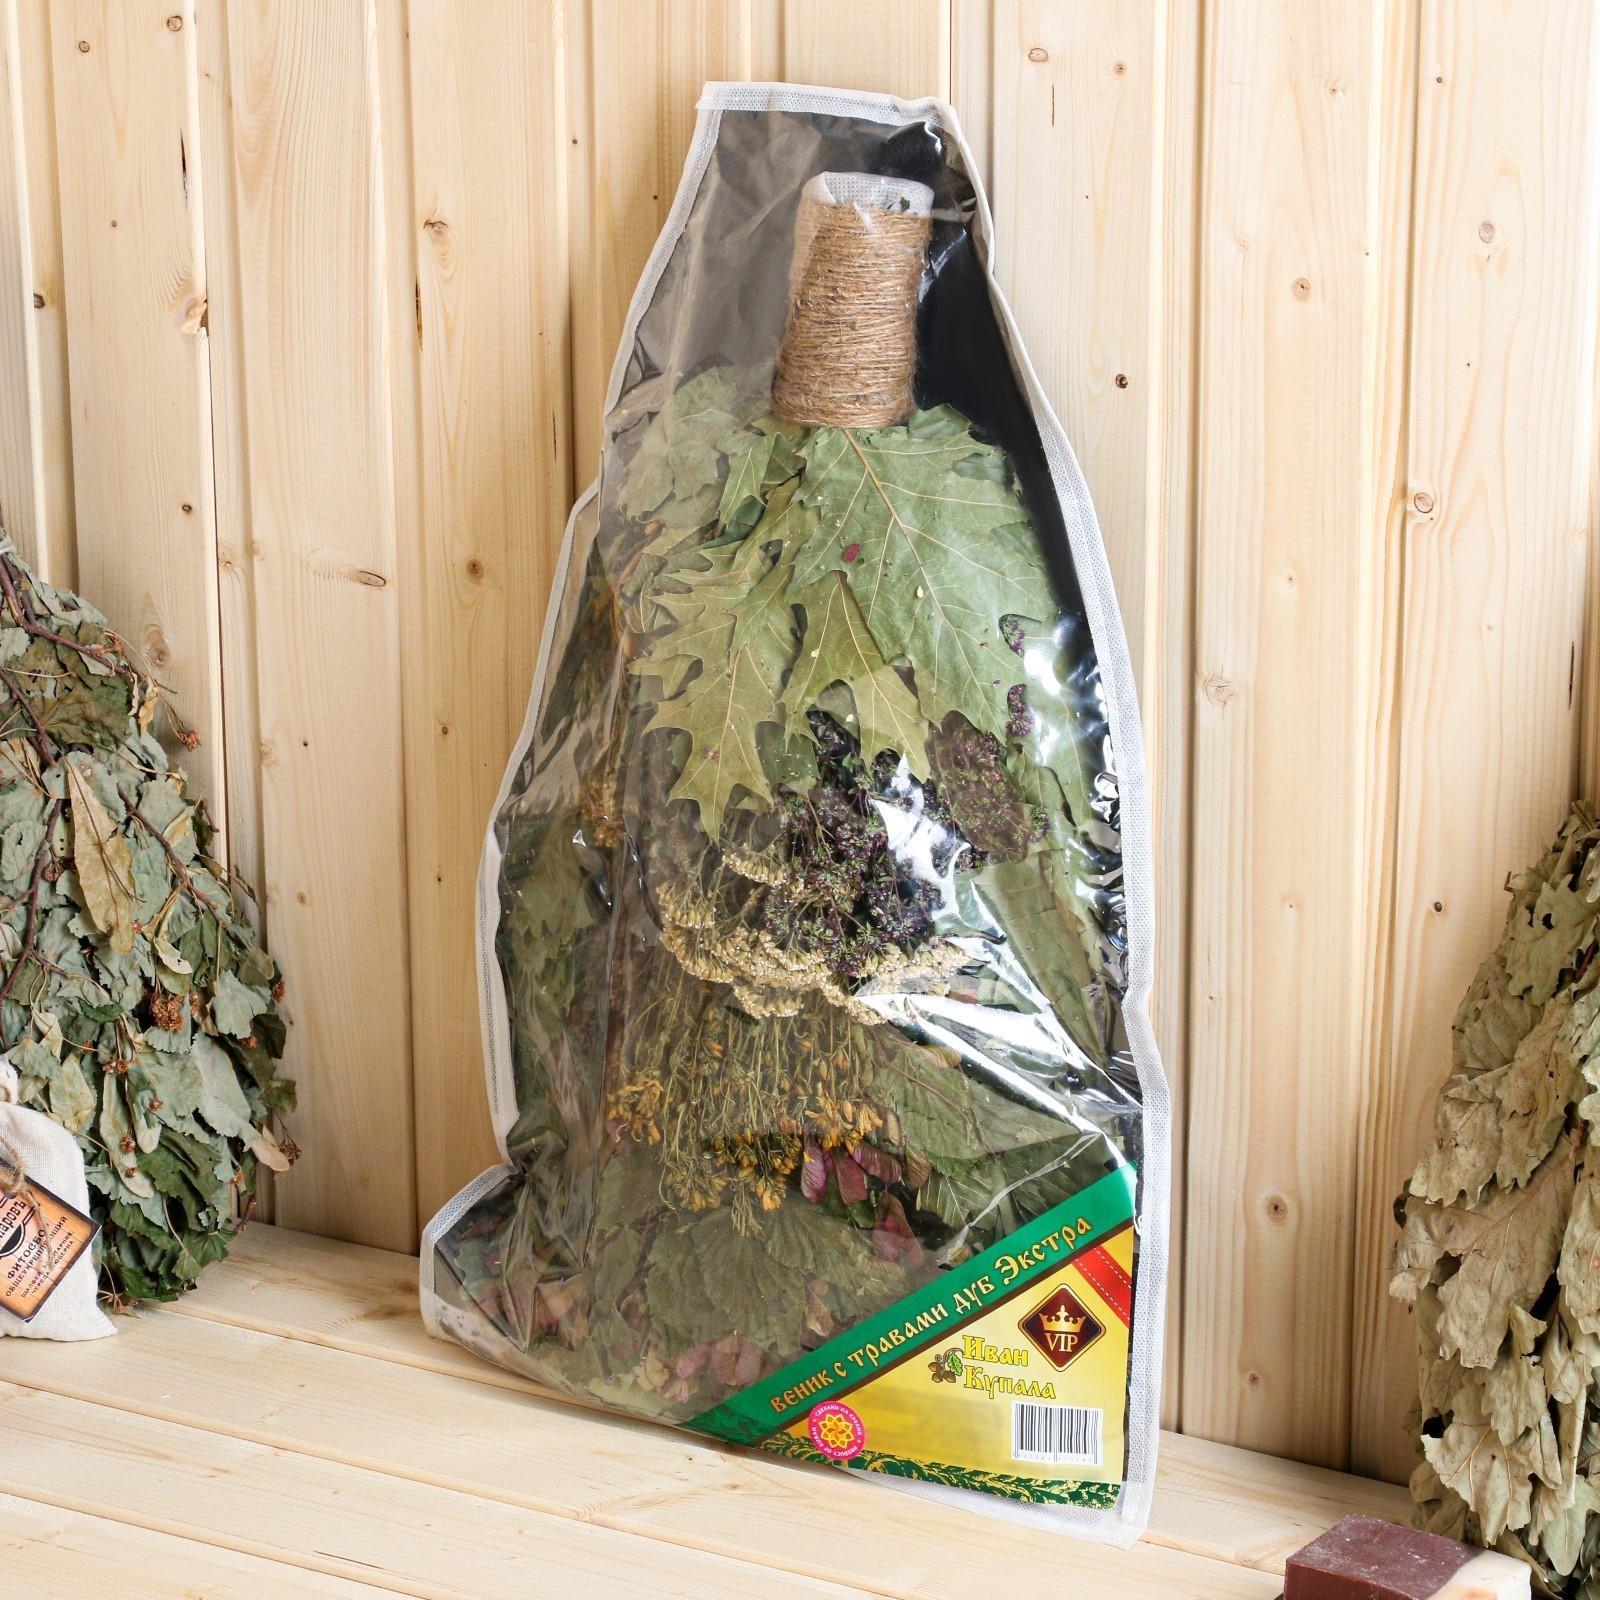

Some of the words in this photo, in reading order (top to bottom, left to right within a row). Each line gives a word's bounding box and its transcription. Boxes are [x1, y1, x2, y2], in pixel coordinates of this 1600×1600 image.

[7, 1222, 49, 1279] ФИТОСБО
[993, 1216, 1093, 1287] Экстра
[962, 1334, 1029, 1367] Иван
[1044, 1332, 1078, 1353] VIP
[963, 1364, 1056, 1400] Купала
